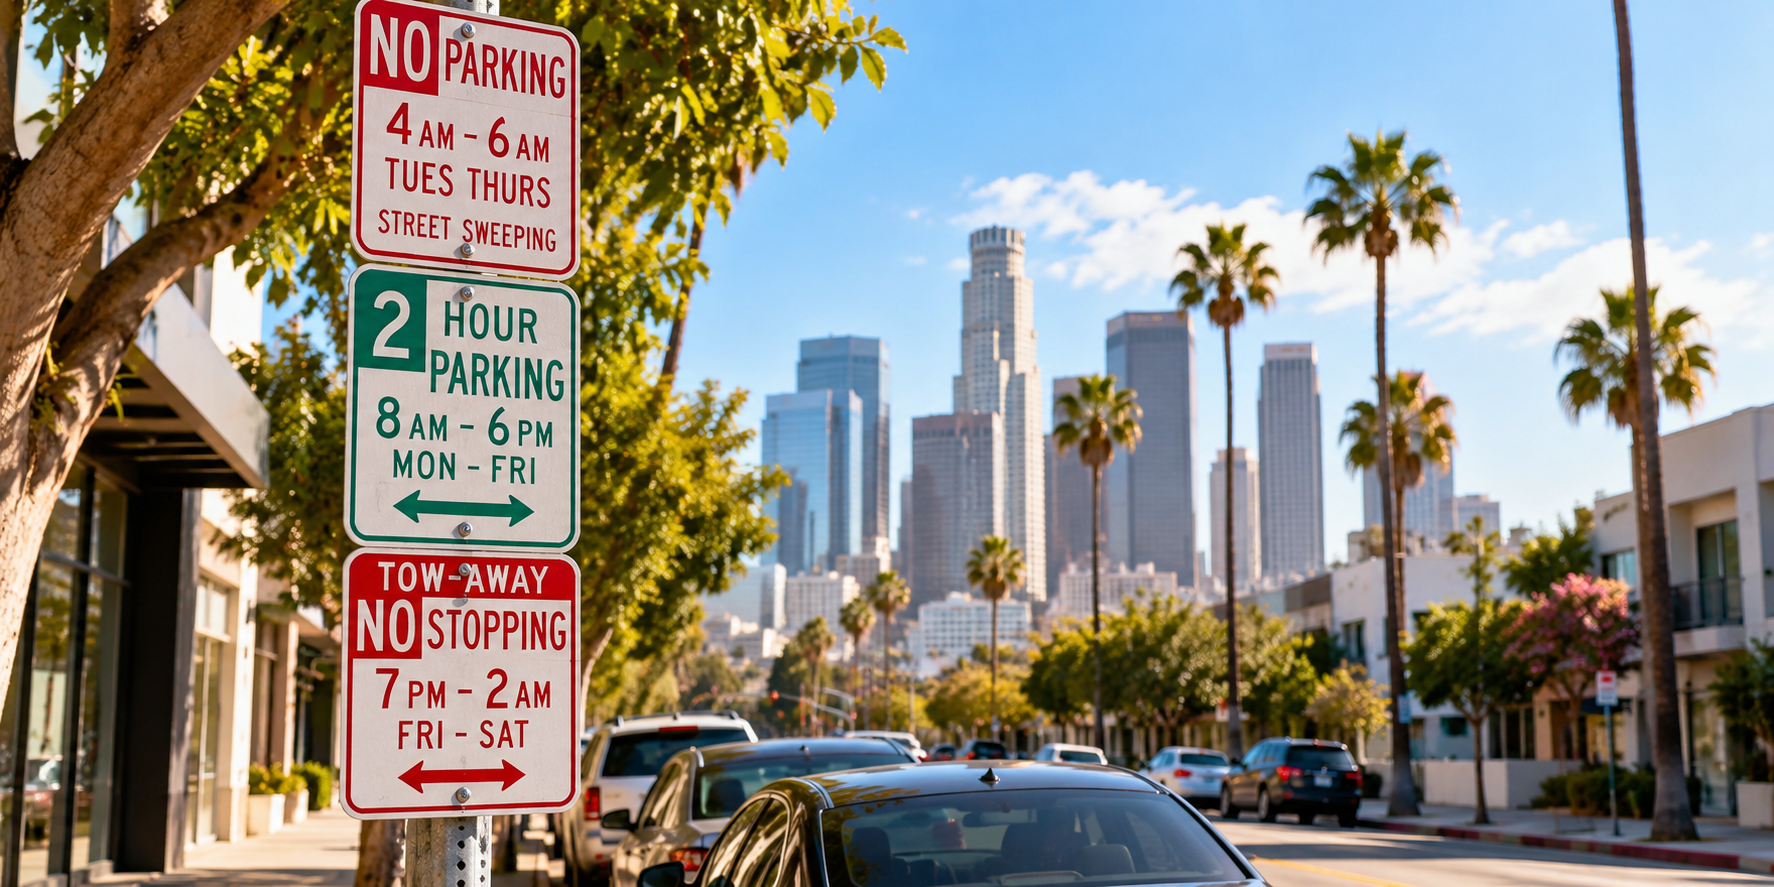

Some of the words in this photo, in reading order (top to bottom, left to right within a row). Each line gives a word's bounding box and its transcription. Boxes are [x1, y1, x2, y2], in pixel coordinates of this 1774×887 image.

[370, 14, 431, 82] NO
[445, 38, 566, 98] PARKING
[386, 102, 412, 145] 4
[419, 120, 454, 150] AM
[488, 116, 510, 158] 6
[516, 133, 549, 163] AM
[385, 156, 453, 196] TUES
[467, 167, 551, 208] THURS
[378, 208, 451, 240] STREET
[462, 219, 556, 252] SWEEPING
[372, 290, 410, 359] 2
[444, 300, 538, 344] HOUR
[430, 349, 565, 402] PARKING
[376, 396, 400, 439] 8
[409, 413, 447, 441] AM
[488, 406, 510, 446] 6
[518, 419, 552, 448] PM
[393, 449, 455, 480] MON
[492, 454, 535, 485] FRI
[378, 561, 549, 594] TOW-AWAY
[357, 599, 416, 652] NO
[427, 609, 567, 651] STOPPING
[376, 668, 399, 709] 7
[408, 680, 446, 709] PM
[486, 668, 508, 709] 2
[515, 681, 550, 708] AM
[398, 720, 443, 749] FRI
[479, 720, 529, 749] SAT
